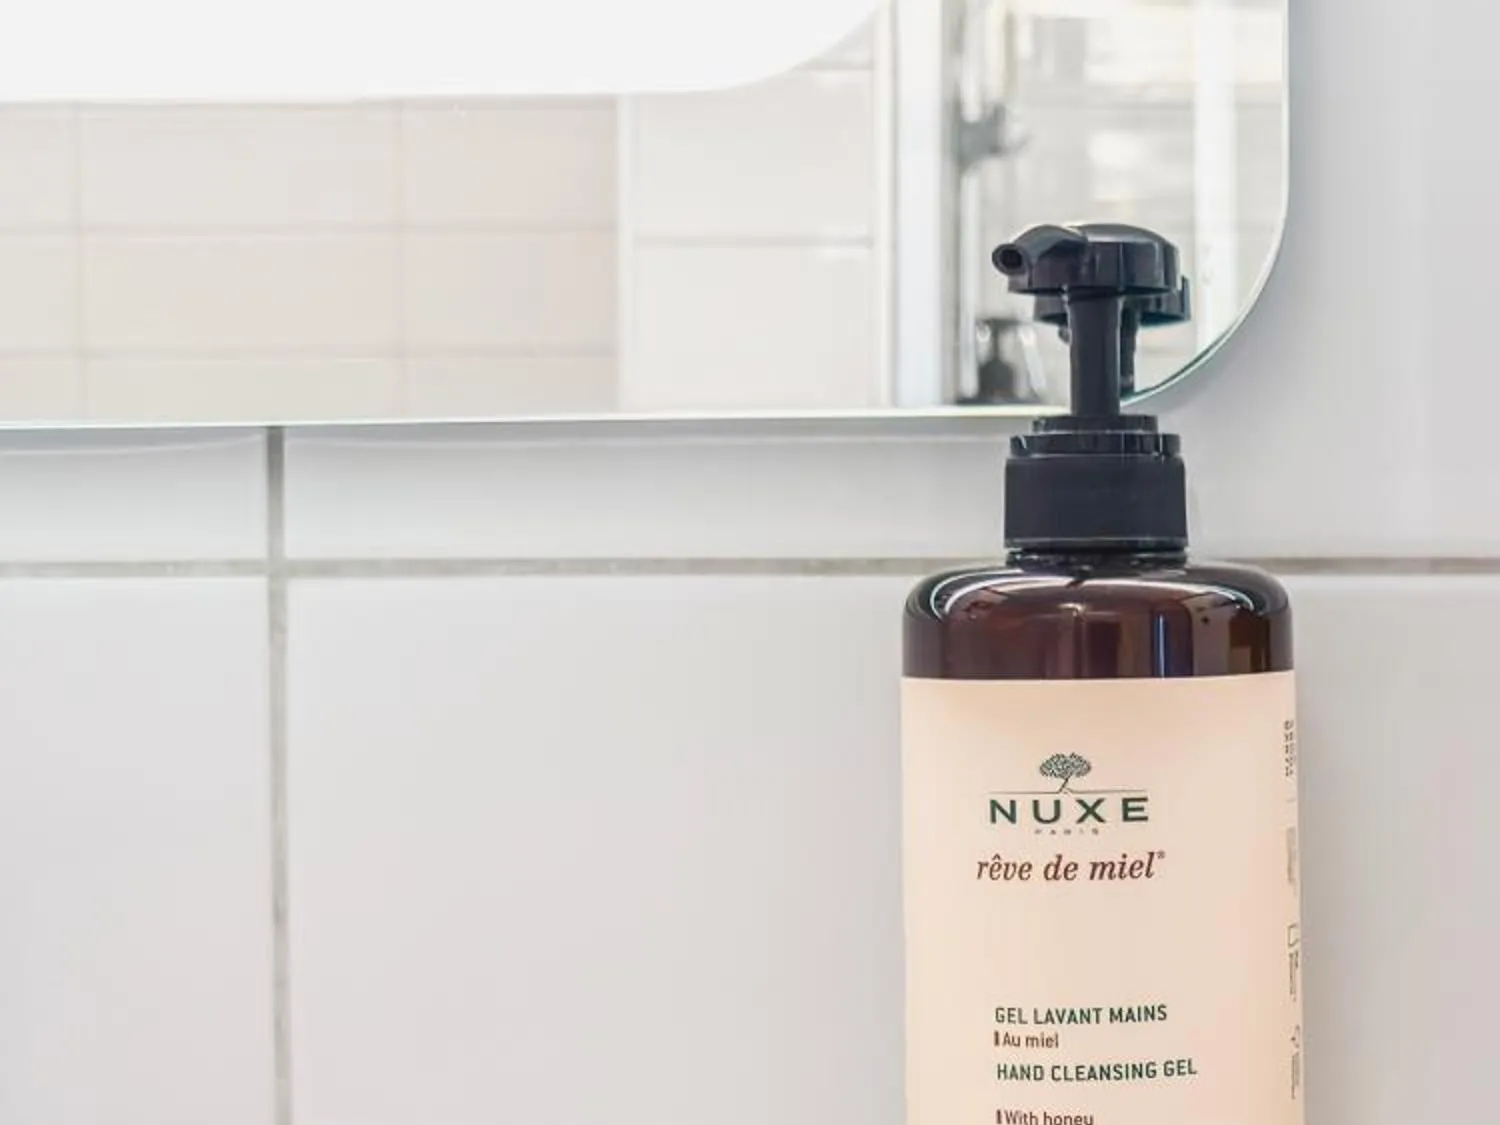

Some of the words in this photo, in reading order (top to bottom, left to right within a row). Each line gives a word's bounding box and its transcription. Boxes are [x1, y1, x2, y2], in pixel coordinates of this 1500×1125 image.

[989, 797, 1149, 824] NUXE
[976, 853, 1033, 881] rêve
[1043, 855, 1078, 881] de
[995, 1006, 1028, 1024] GEL
[1033, 1008, 1103, 1025] LAVANT
[1109, 1004, 1168, 1024] MAINS
[1002, 1032, 1021, 1048] Au
[1025, 1033, 1059, 1048] miel
[996, 1064, 1045, 1081] HAND
[1051, 1062, 1157, 1082] CLEANSING
[1162, 1058, 1198, 1077] GEL
